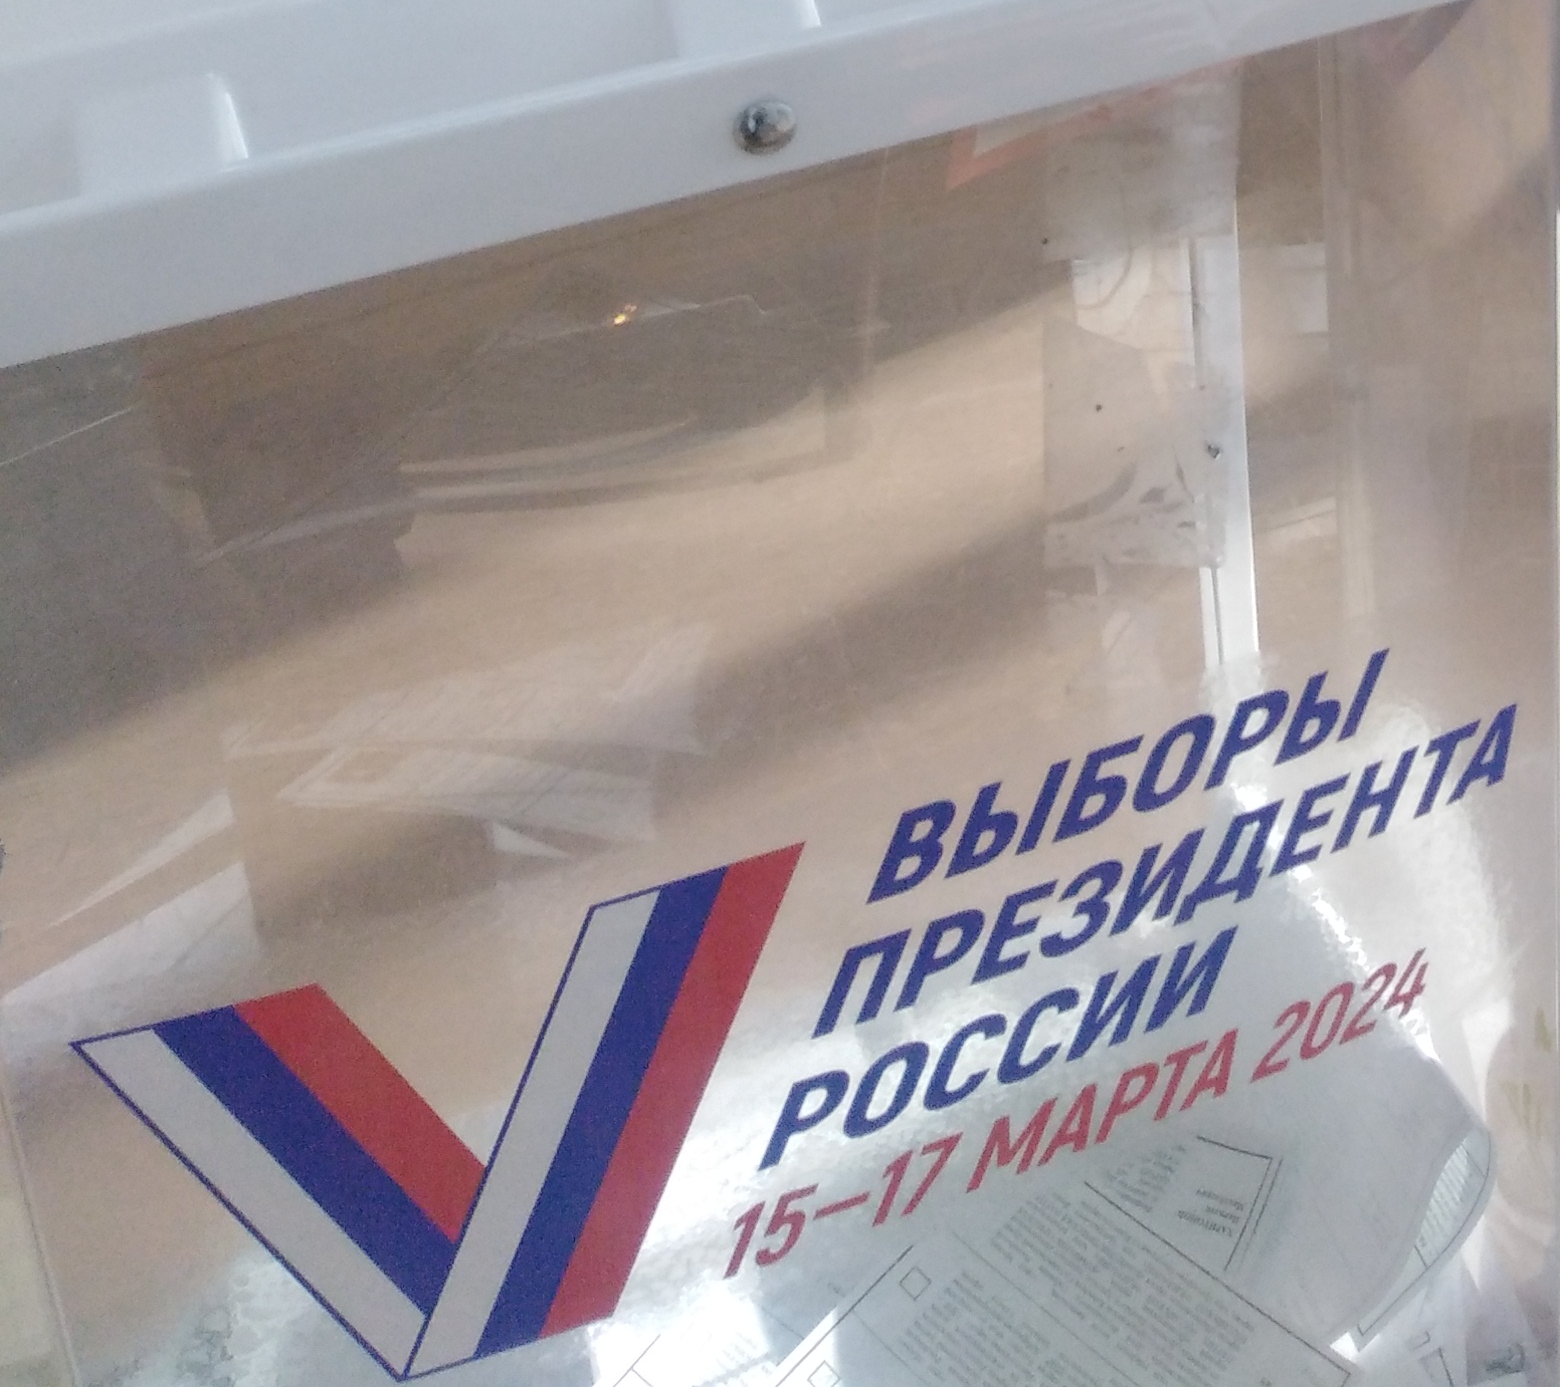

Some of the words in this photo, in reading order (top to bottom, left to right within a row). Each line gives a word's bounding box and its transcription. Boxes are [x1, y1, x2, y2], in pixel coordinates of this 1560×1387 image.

[811, 704, 1519, 1040] ПРЕЗИДЕНТА
[866, 648, 1391, 904] ВЫБОРЫ
[758, 926, 1238, 1171] РОССИИ
[966, 1030, 1233, 1193] МАРТА
[1250, 947, 1428, 1085] 2024
